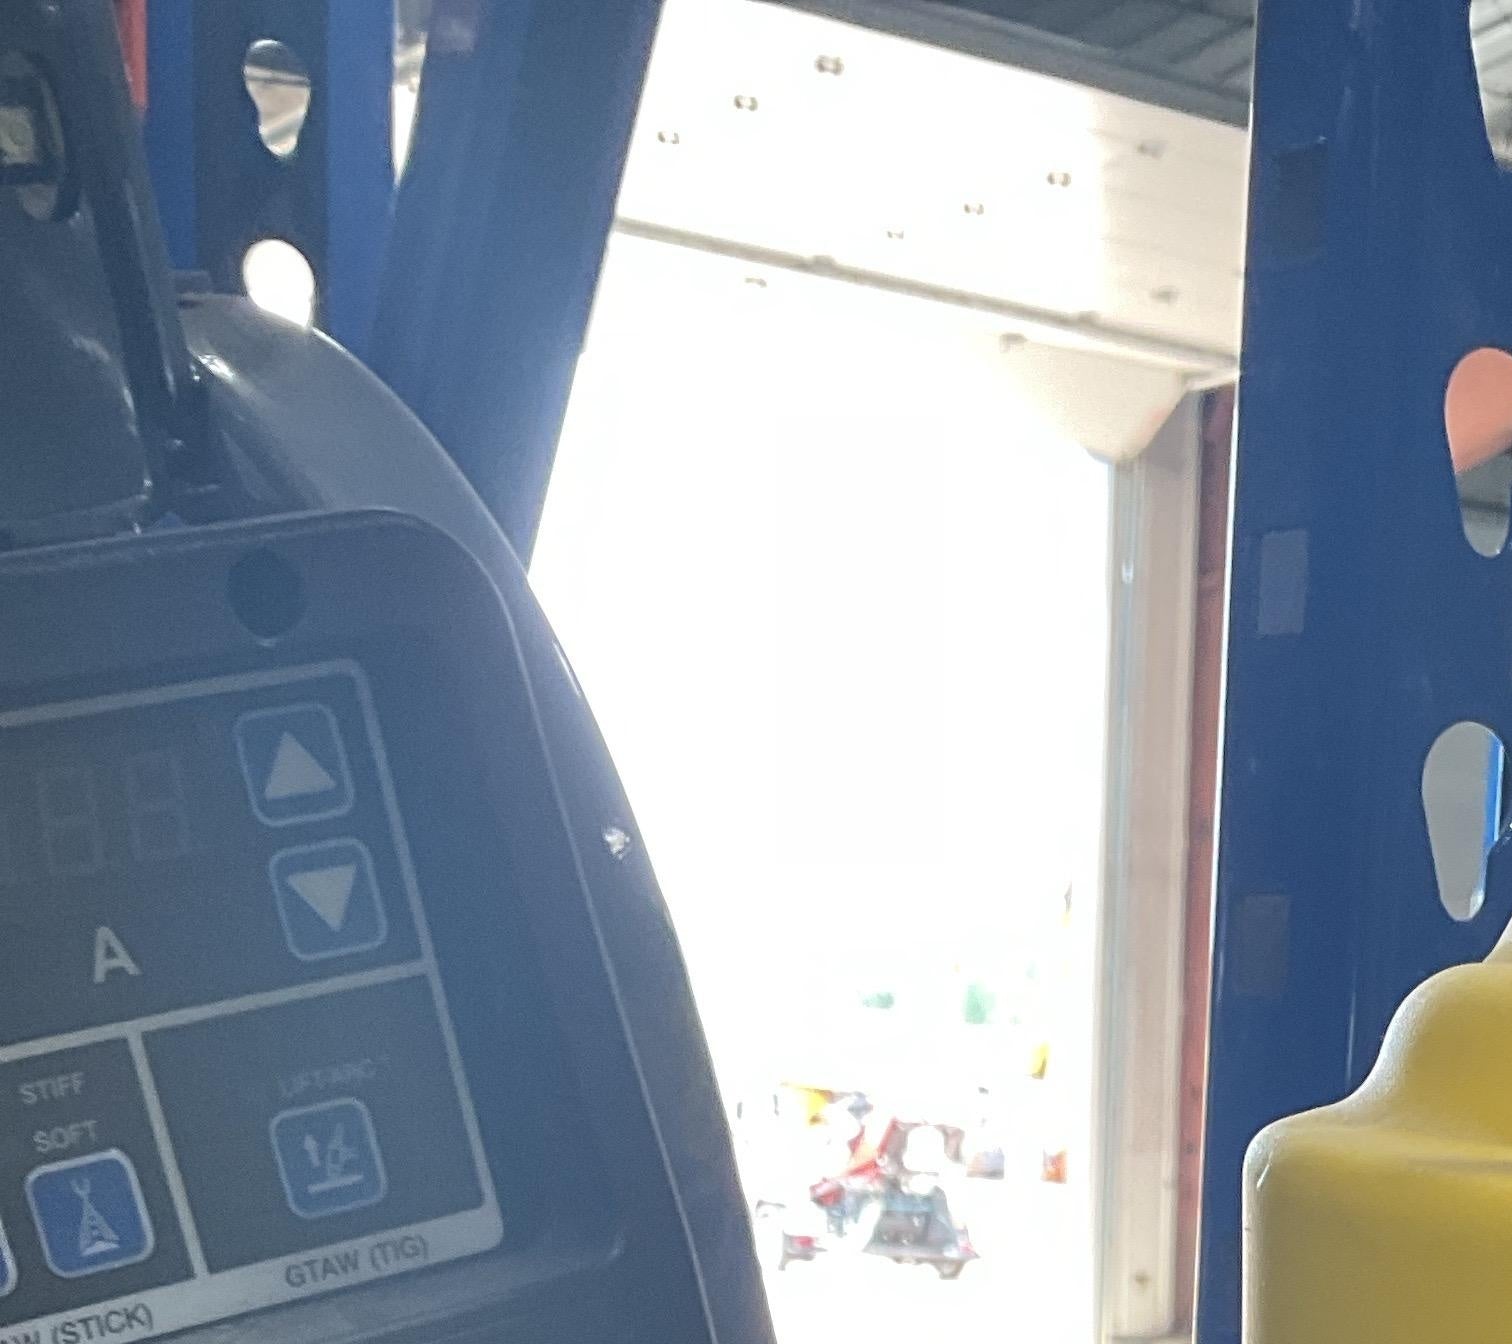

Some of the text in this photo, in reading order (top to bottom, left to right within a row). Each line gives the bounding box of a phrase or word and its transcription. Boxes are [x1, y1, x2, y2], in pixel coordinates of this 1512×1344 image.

[92, 926, 142, 984] A
[19, 1071, 85, 1106] STIFF
[32, 1119, 98, 1153] SOFT
[284, 1233, 429, 1289] GTAW (TIG)
